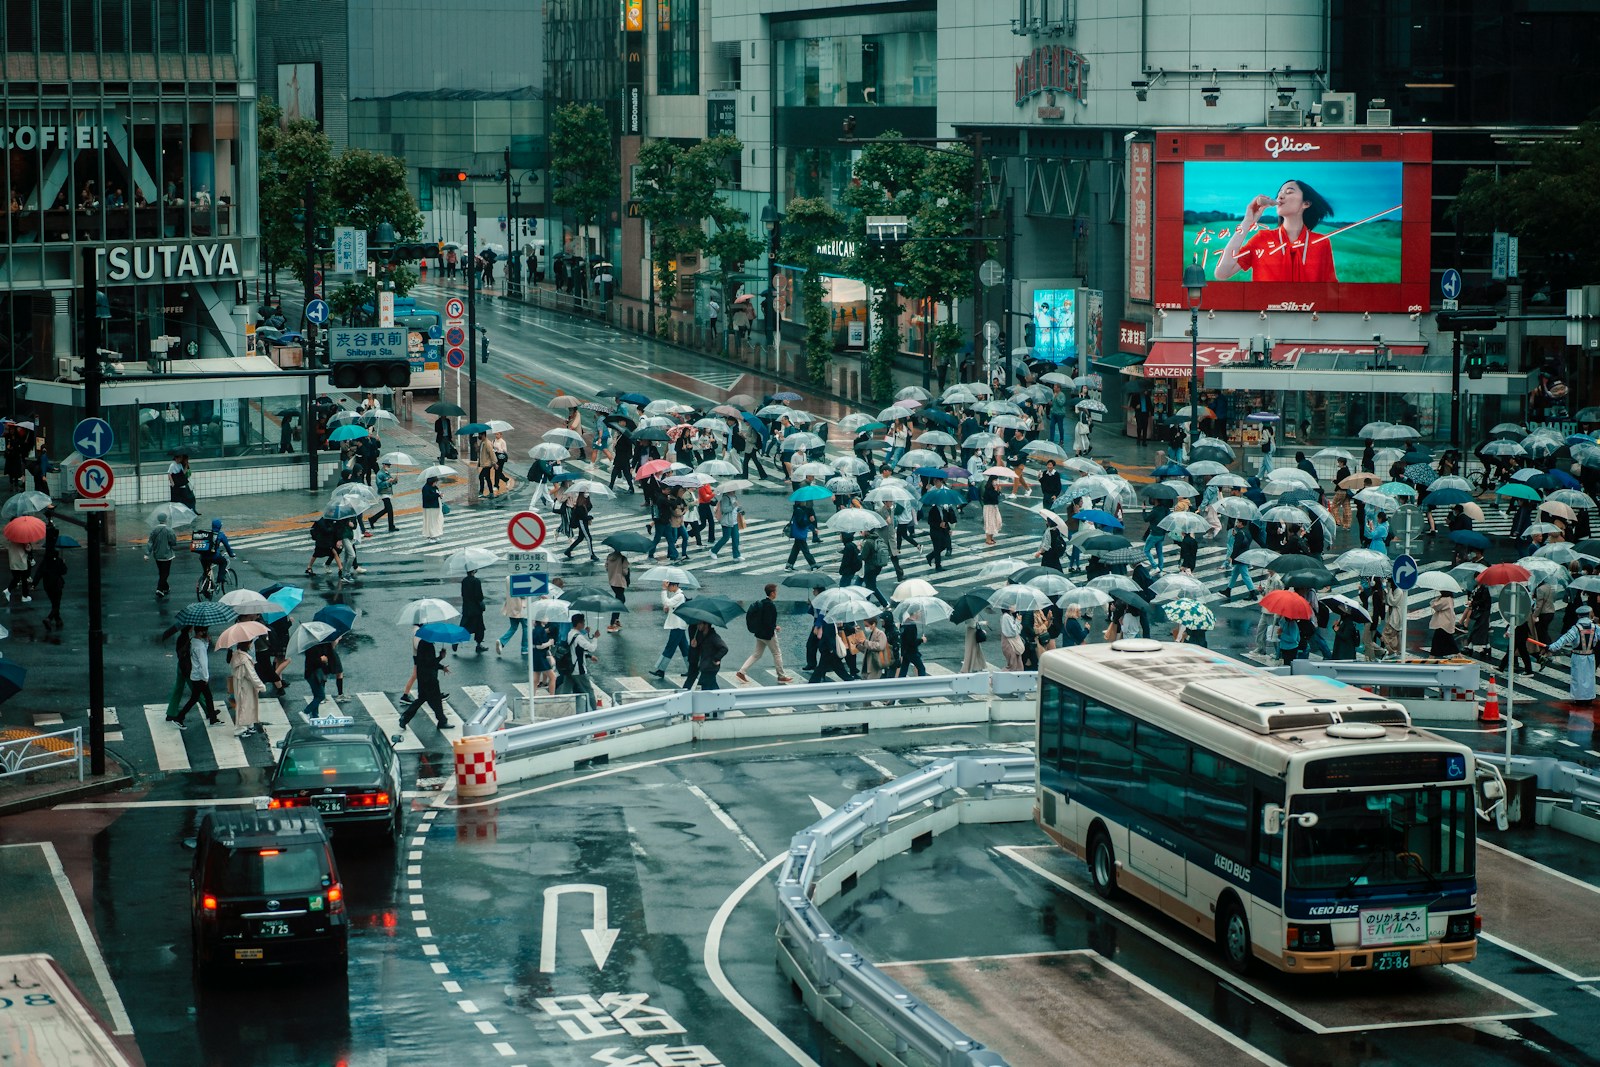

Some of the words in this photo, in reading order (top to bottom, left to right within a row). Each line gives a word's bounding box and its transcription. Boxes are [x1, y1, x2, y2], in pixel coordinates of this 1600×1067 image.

[1015, 45, 1089, 106] MAGNET
[631, 87, 639, 132] McDonald's
[0, 125, 108, 150] COFFEE
[1132, 146, 1149, 163] 名物
[1265, 136, 1321, 158] Glico
[1133, 166, 1147, 295] 天津甘栗
[1193, 221, 1271, 246] なめらか
[343, 231, 353, 270] 渋谷駅前
[816, 240, 855, 258] AMERICAN
[1408, 304, 1422, 312] pdc
[336, 332, 402, 348] 渋谷駅前
[1120, 328, 1146, 346] 天津甘栗
[346, 348, 377, 357] Shibuya
[379, 347, 395, 356] Sta.
[1148, 367, 1193, 377] SANZENR
[514, 563, 541, 571] 6-22
[1214, 853, 1234, 873] KEIO
[1232, 862, 1251, 882] BUS
[1309, 906, 1335, 916] KEIO
[1335, 904, 1359, 914] BUS
[1366, 910, 1421, 925] のりかえよう、
[1367, 922, 1421, 936] モバイルへ。
[1379, 955, 1409, 970] 23-86
